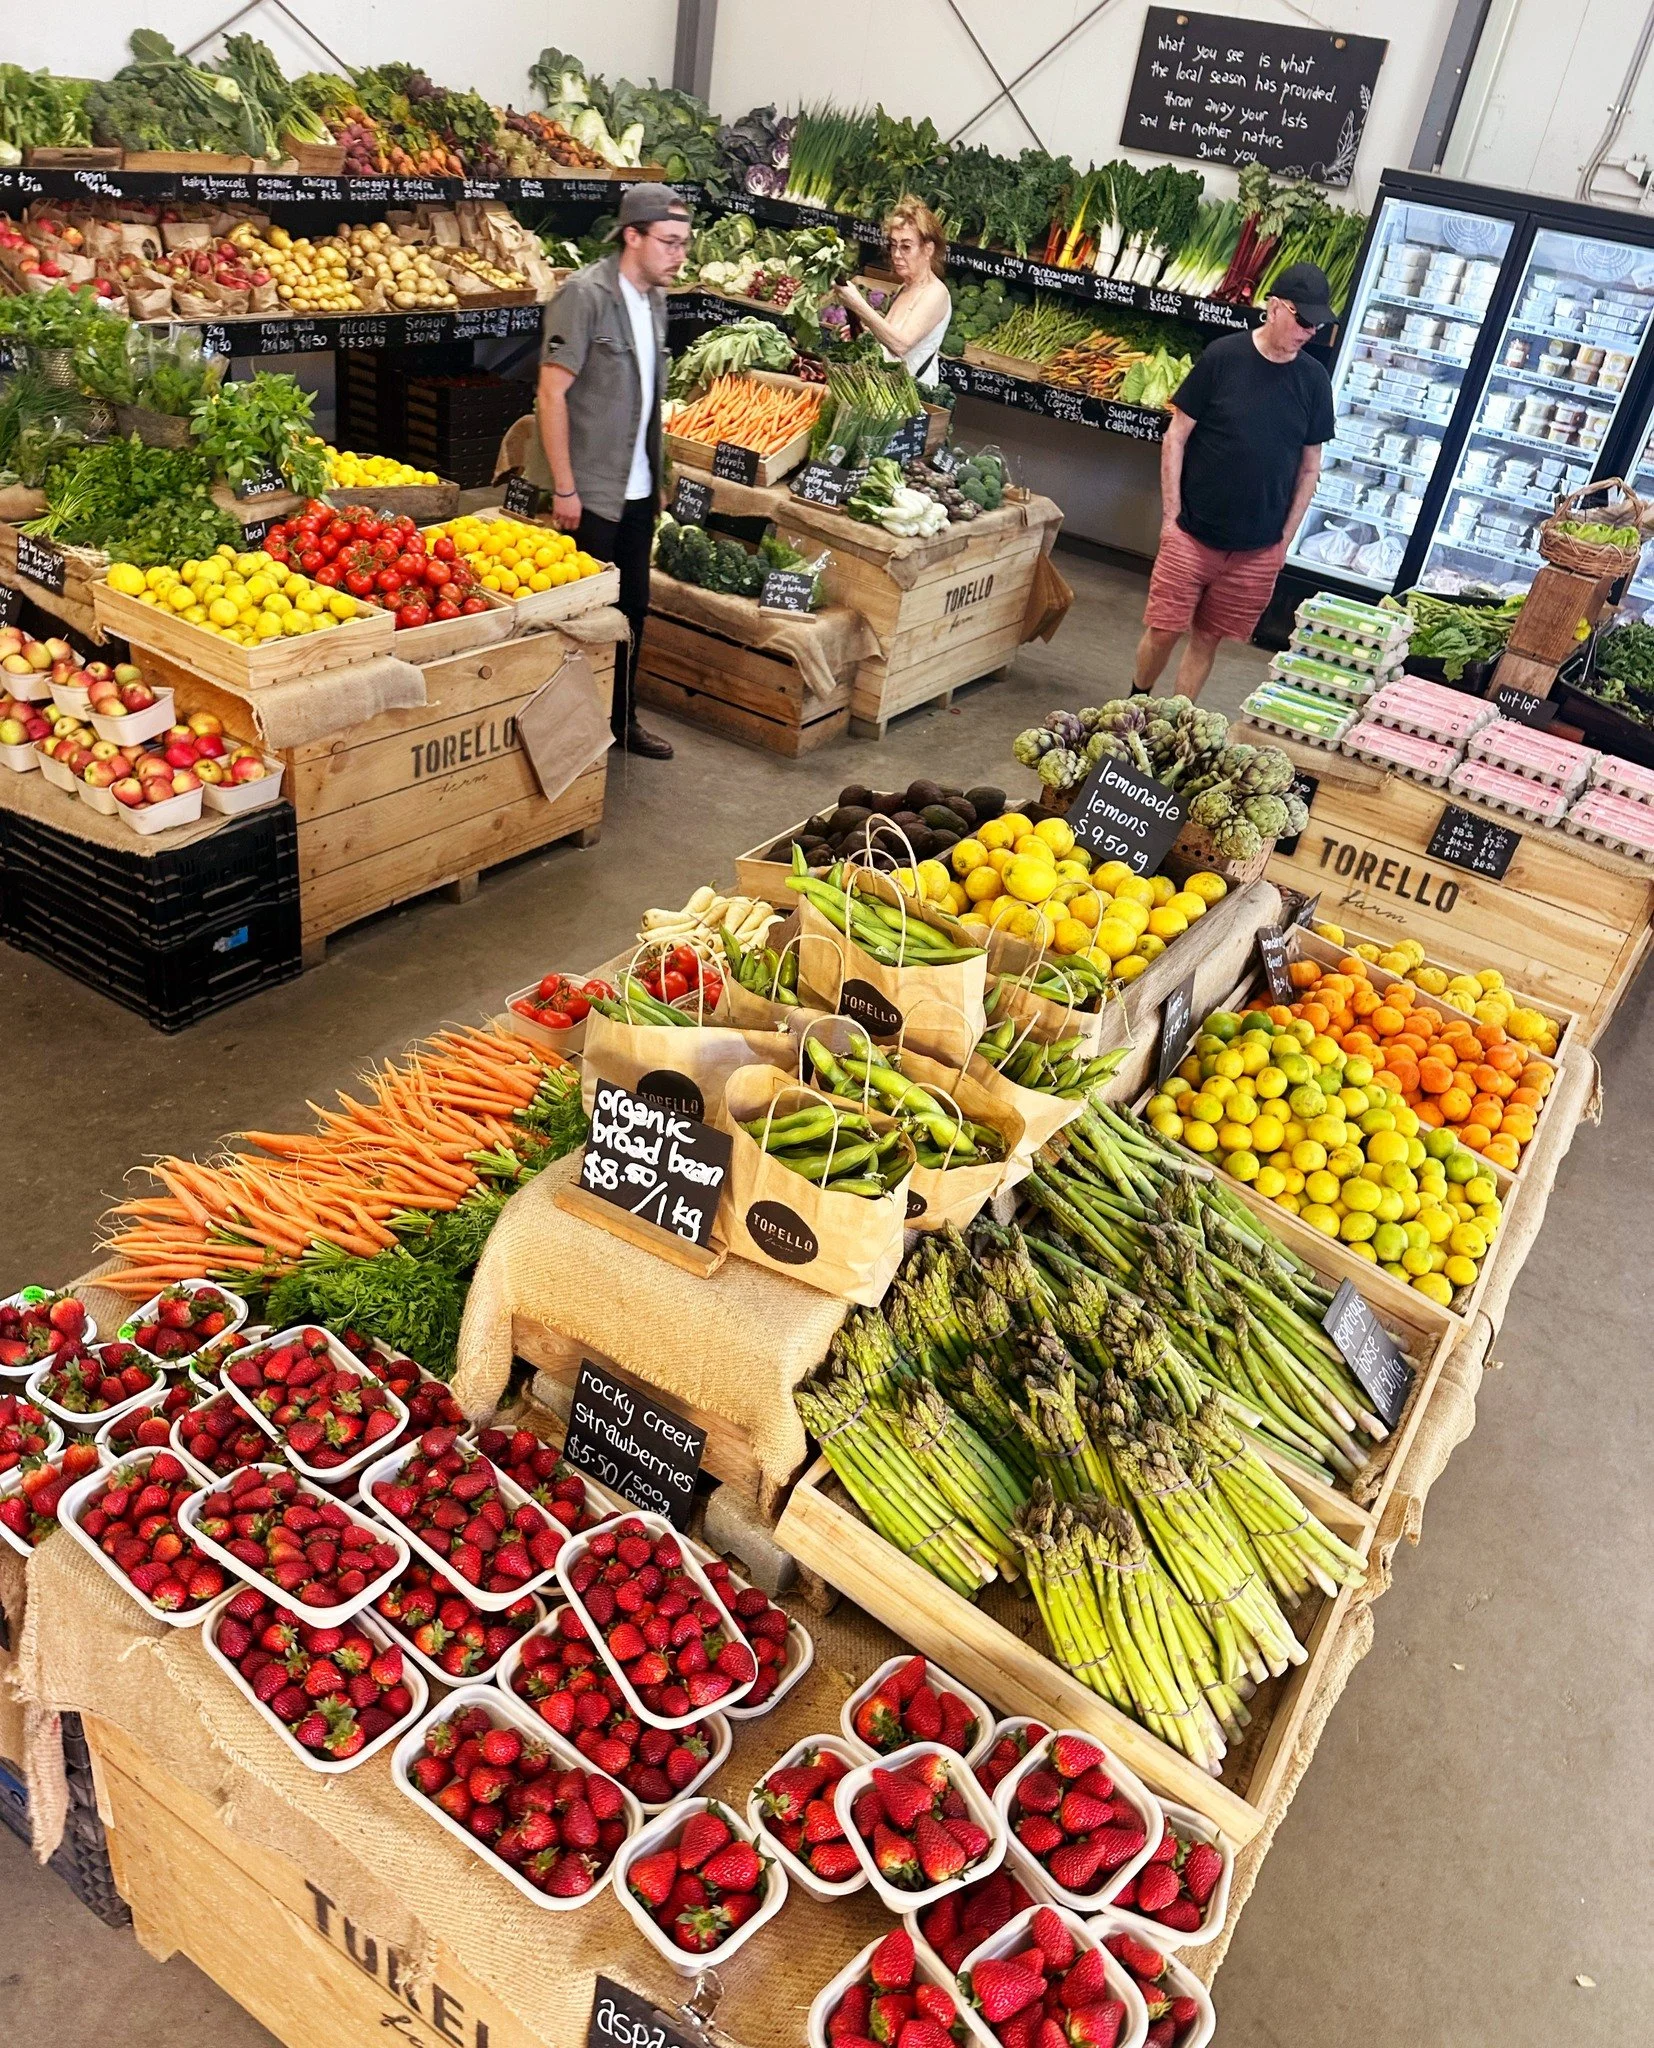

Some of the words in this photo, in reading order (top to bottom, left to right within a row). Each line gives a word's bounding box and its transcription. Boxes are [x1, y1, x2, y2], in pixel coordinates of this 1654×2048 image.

[1151, 60, 1169, 78] the
[1176, 61, 1204, 84] local
[1209, 70, 1247, 88] season
[1255, 73, 1277, 93] has
[1191, 44, 1218, 62] you
[1225, 48, 1245, 63] see
[1259, 51, 1272, 68] is
[1163, 89, 1194, 108] throw
[1204, 98, 1236, 122] away
[1238, 106, 1269, 125] your
[1281, 107, 1309, 130] lists
[1139, 113, 1159, 128] and
[1168, 114, 1187, 133] let
[1191, 121, 1232, 140] mother
[1241, 127, 1285, 149] nature
[1196, 141, 1227, 159] guide
[181, 175, 206, 191] baby
[208, 174, 247, 188] broccoli
[1193, 298, 1233, 318] rhubarb
[974, 380, 1001, 396] loose
[244, 521, 267, 541] local
[943, 574, 994, 615] TORELLO
[411, 715, 518, 779] TORELLO
[1098, 760, 1181, 821] lemonade
[1086, 789, 1150, 838] lemons
[1319, 837, 1460, 914] TORELLO
[843, 993, 898, 1024] TORELLO
[598, 1089, 697, 1144] organic
[592, 1109, 664, 1166] broad
[667, 1141, 724, 1187] bean
[753, 1212, 814, 1253] TORELLO
[1352, 1335, 1380, 1376] loose
[581, 1370, 635, 1427] rocky
[643, 1410, 701, 1457] creek
[597, 1998, 681, 2048] aspa
